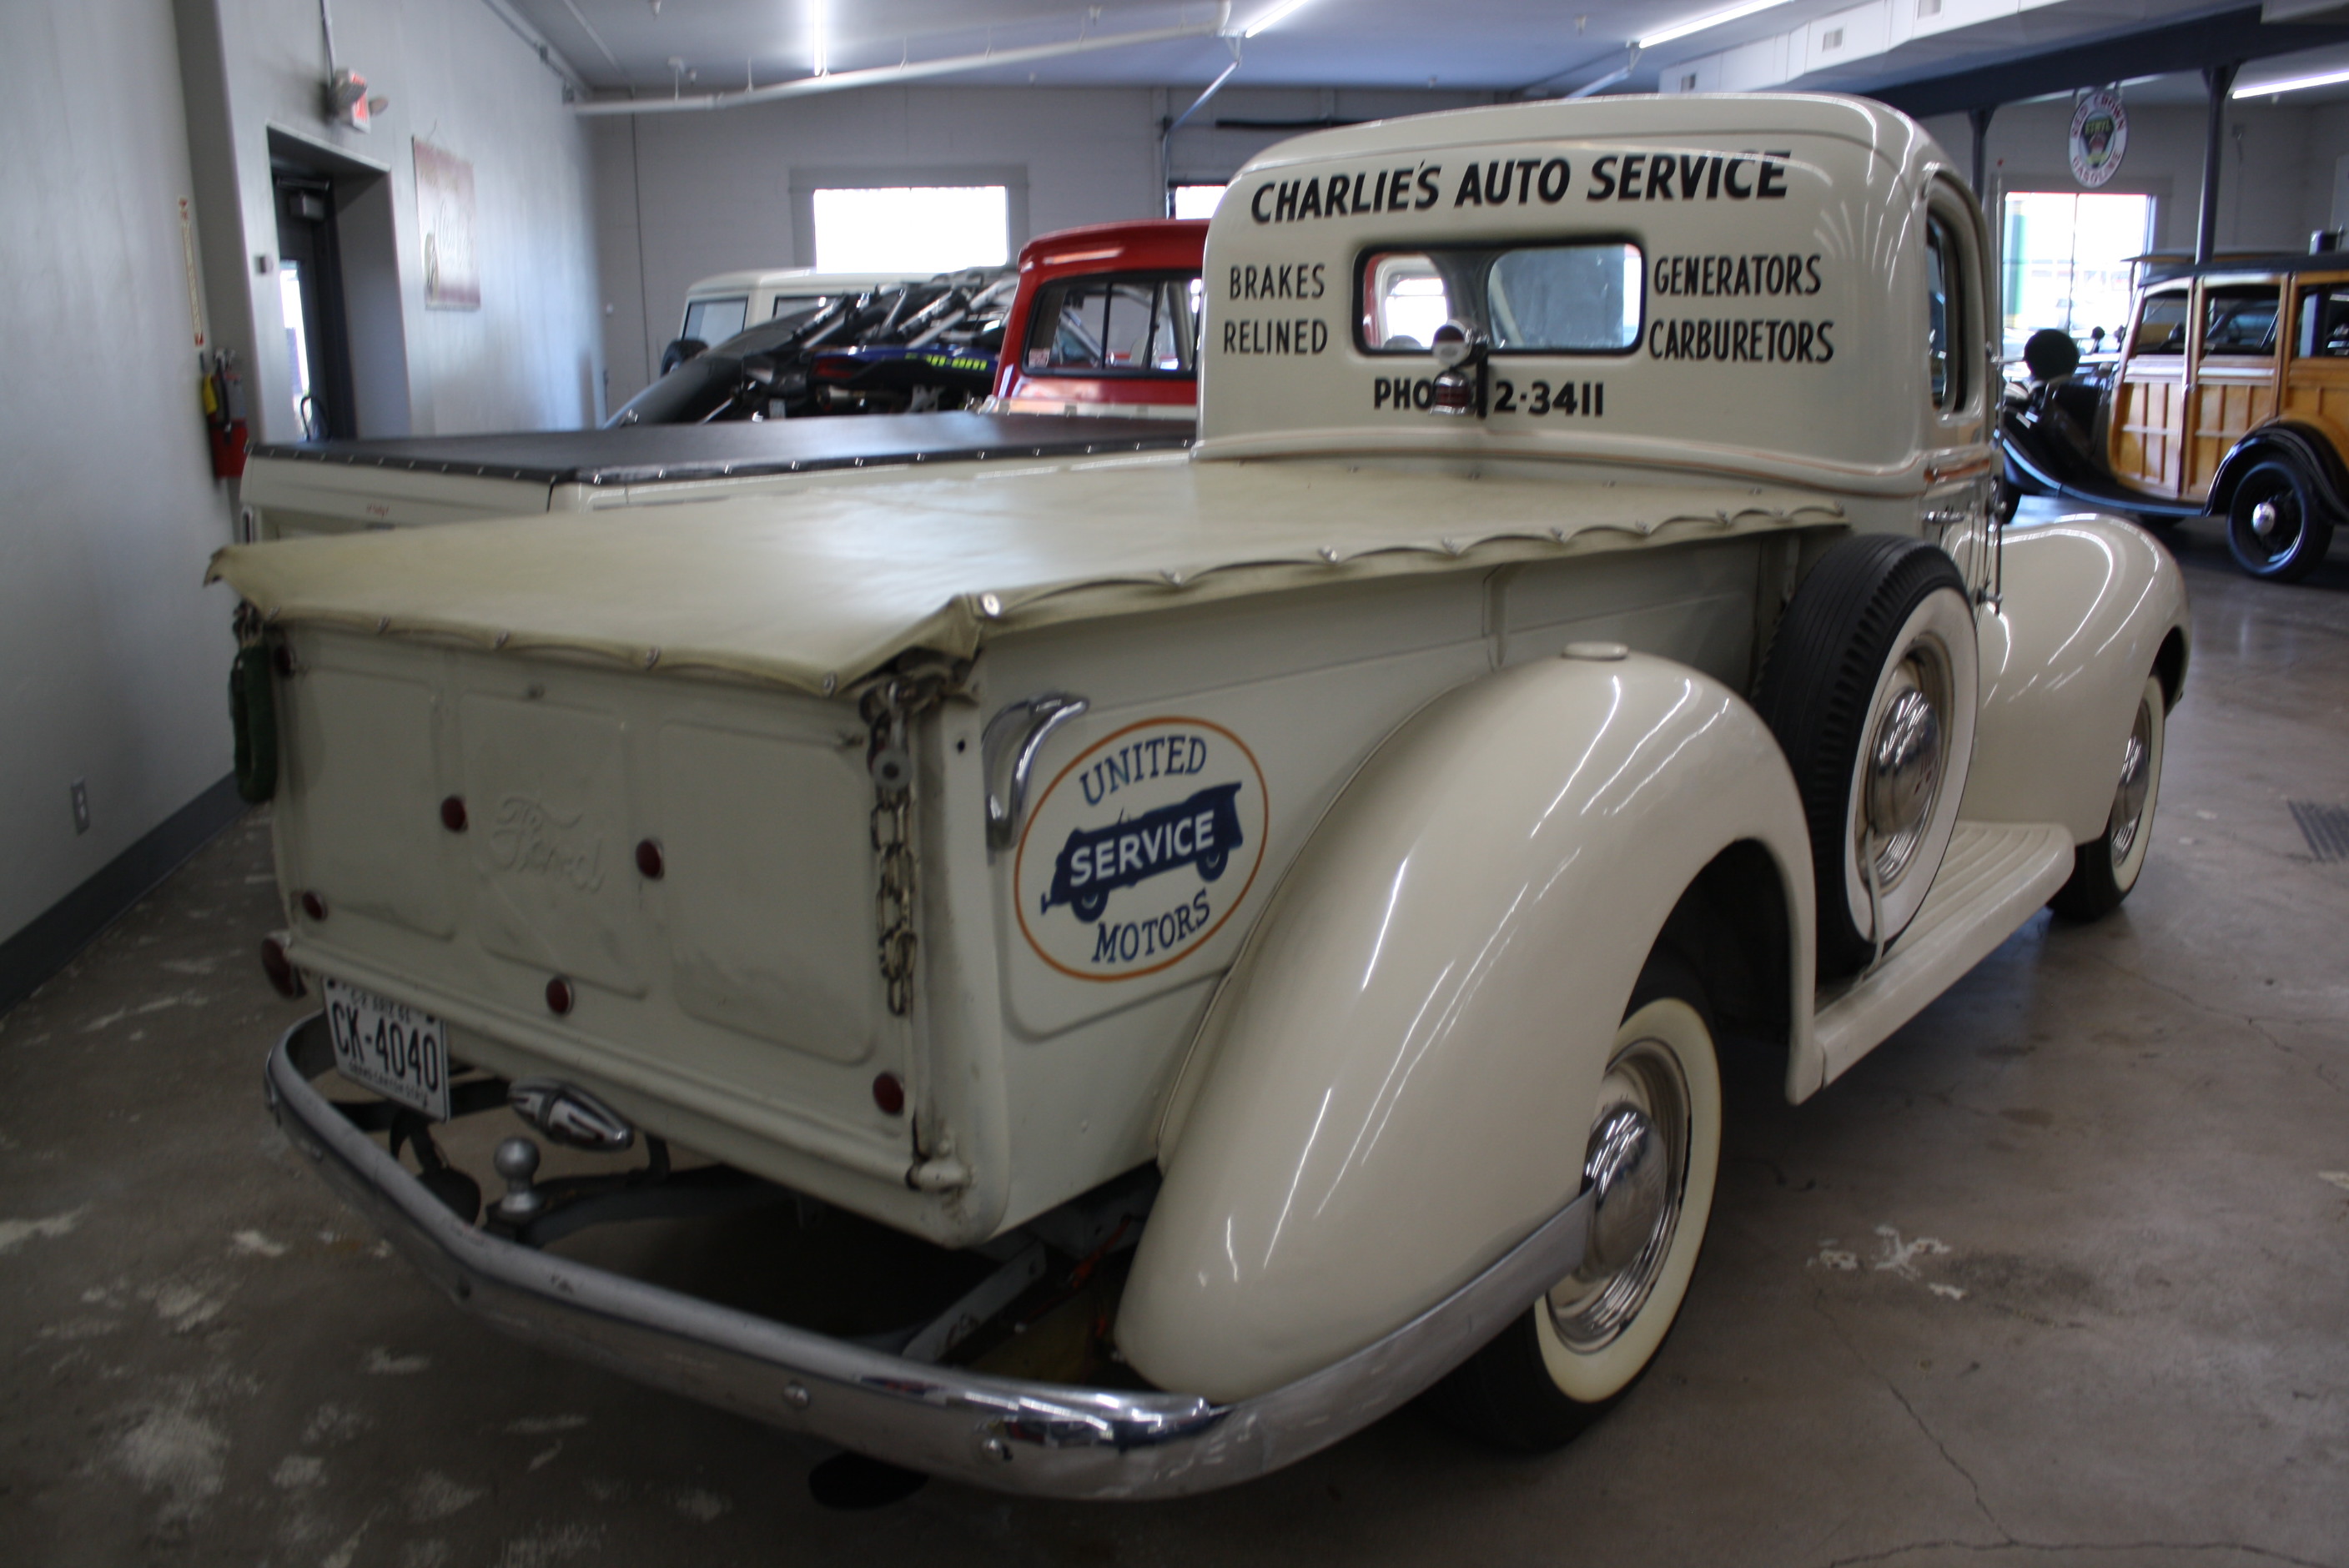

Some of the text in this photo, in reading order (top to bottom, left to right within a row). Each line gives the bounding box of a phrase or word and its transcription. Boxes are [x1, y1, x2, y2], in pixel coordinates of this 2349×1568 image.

[1251, 149, 1791, 224] CHARLIE'S AUTO SERVICE
[1230, 263, 1325, 300] BRAKES
[1654, 254, 1822, 296] GENERATORS
[1224, 319, 1328, 355] RELINED
[1648, 318, 1834, 364] CARBURETORS
[1374, 377, 1471, 410] PHO
[1079, 736, 1207, 806] UNITED
[1070, 809, 1215, 887] SERVICE
[1091, 887, 1211, 964] MOTORS
[332, 1001, 439, 1092] CK-4040
